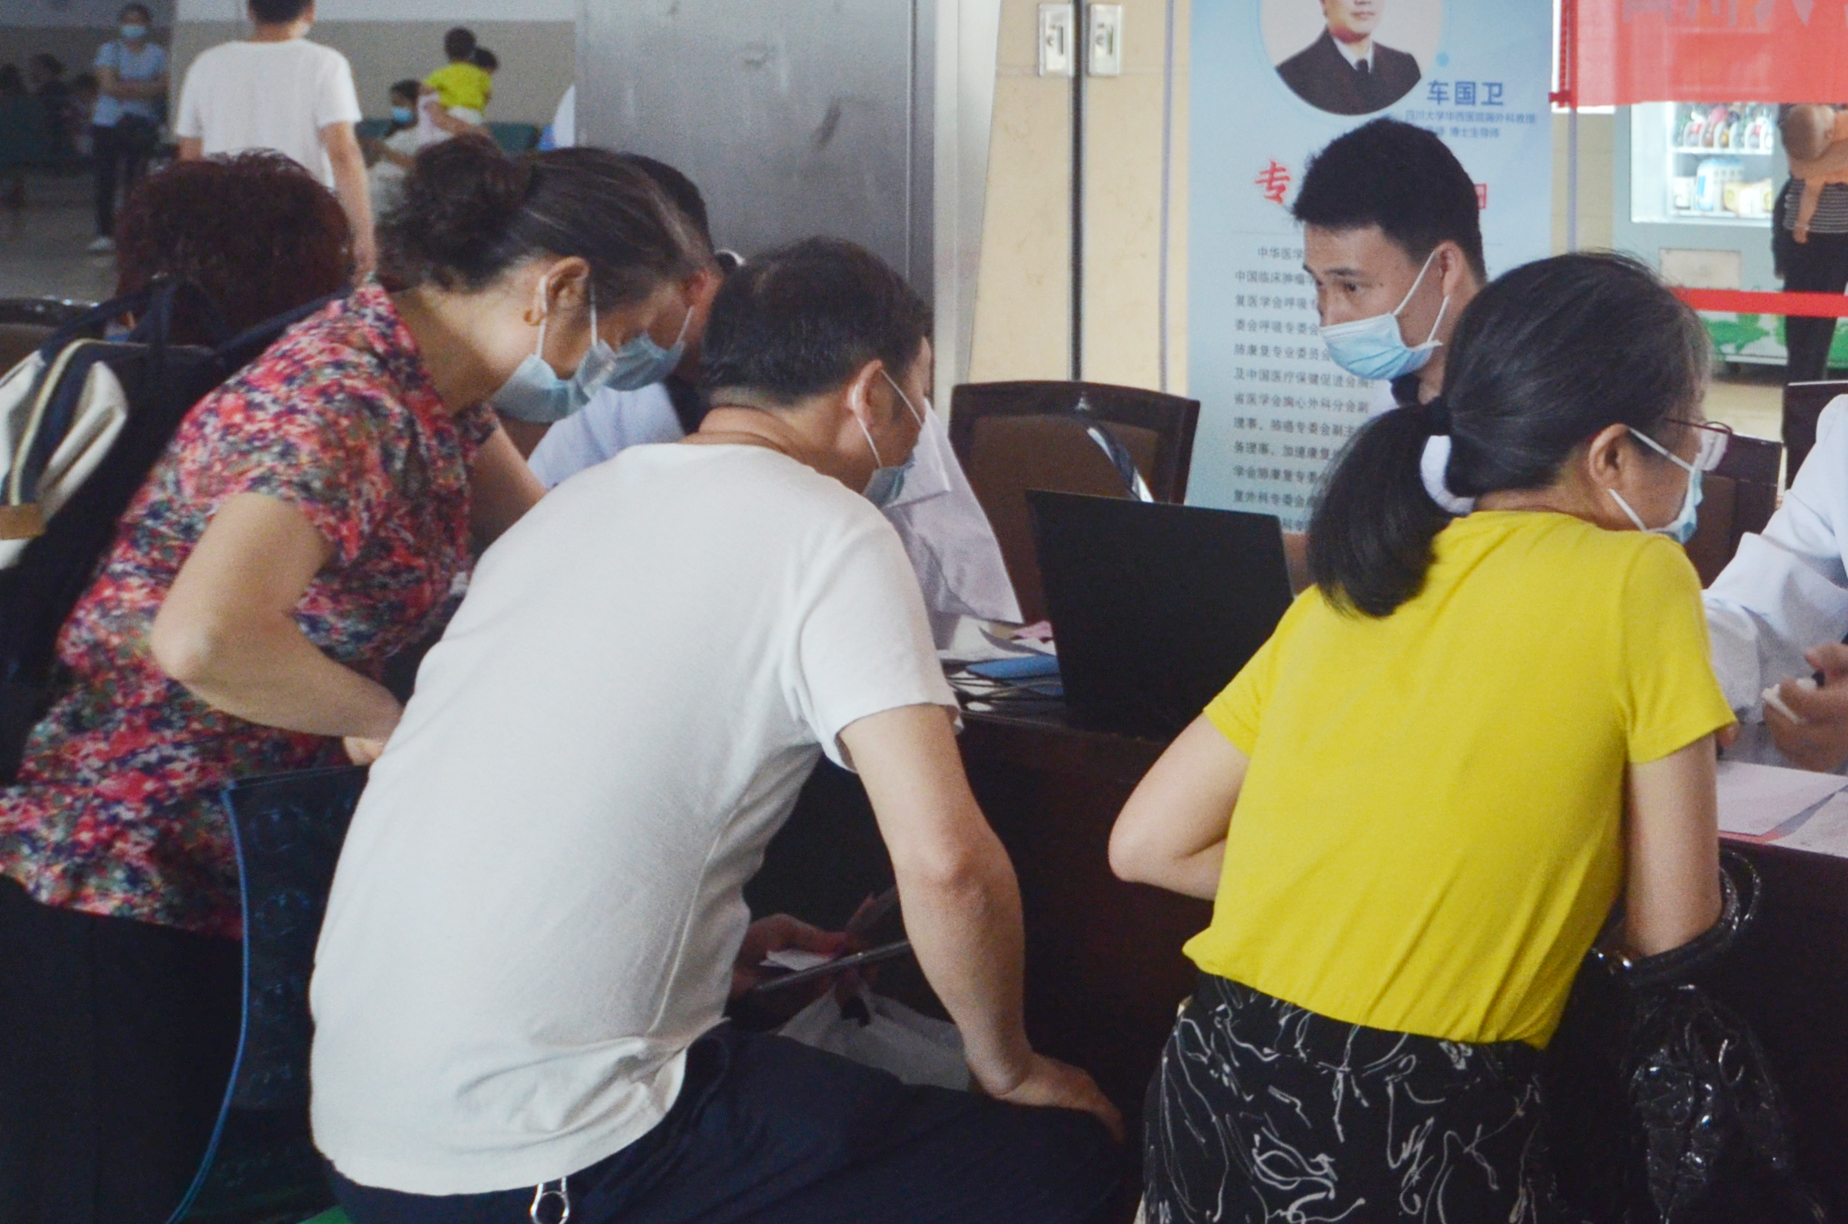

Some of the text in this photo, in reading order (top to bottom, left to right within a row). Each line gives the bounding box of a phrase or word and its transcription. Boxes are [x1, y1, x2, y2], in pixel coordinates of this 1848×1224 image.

[1426, 79, 1504, 107] 车国卫
[1233, 366, 1375, 389] 及中国医疗保健促进会胸
